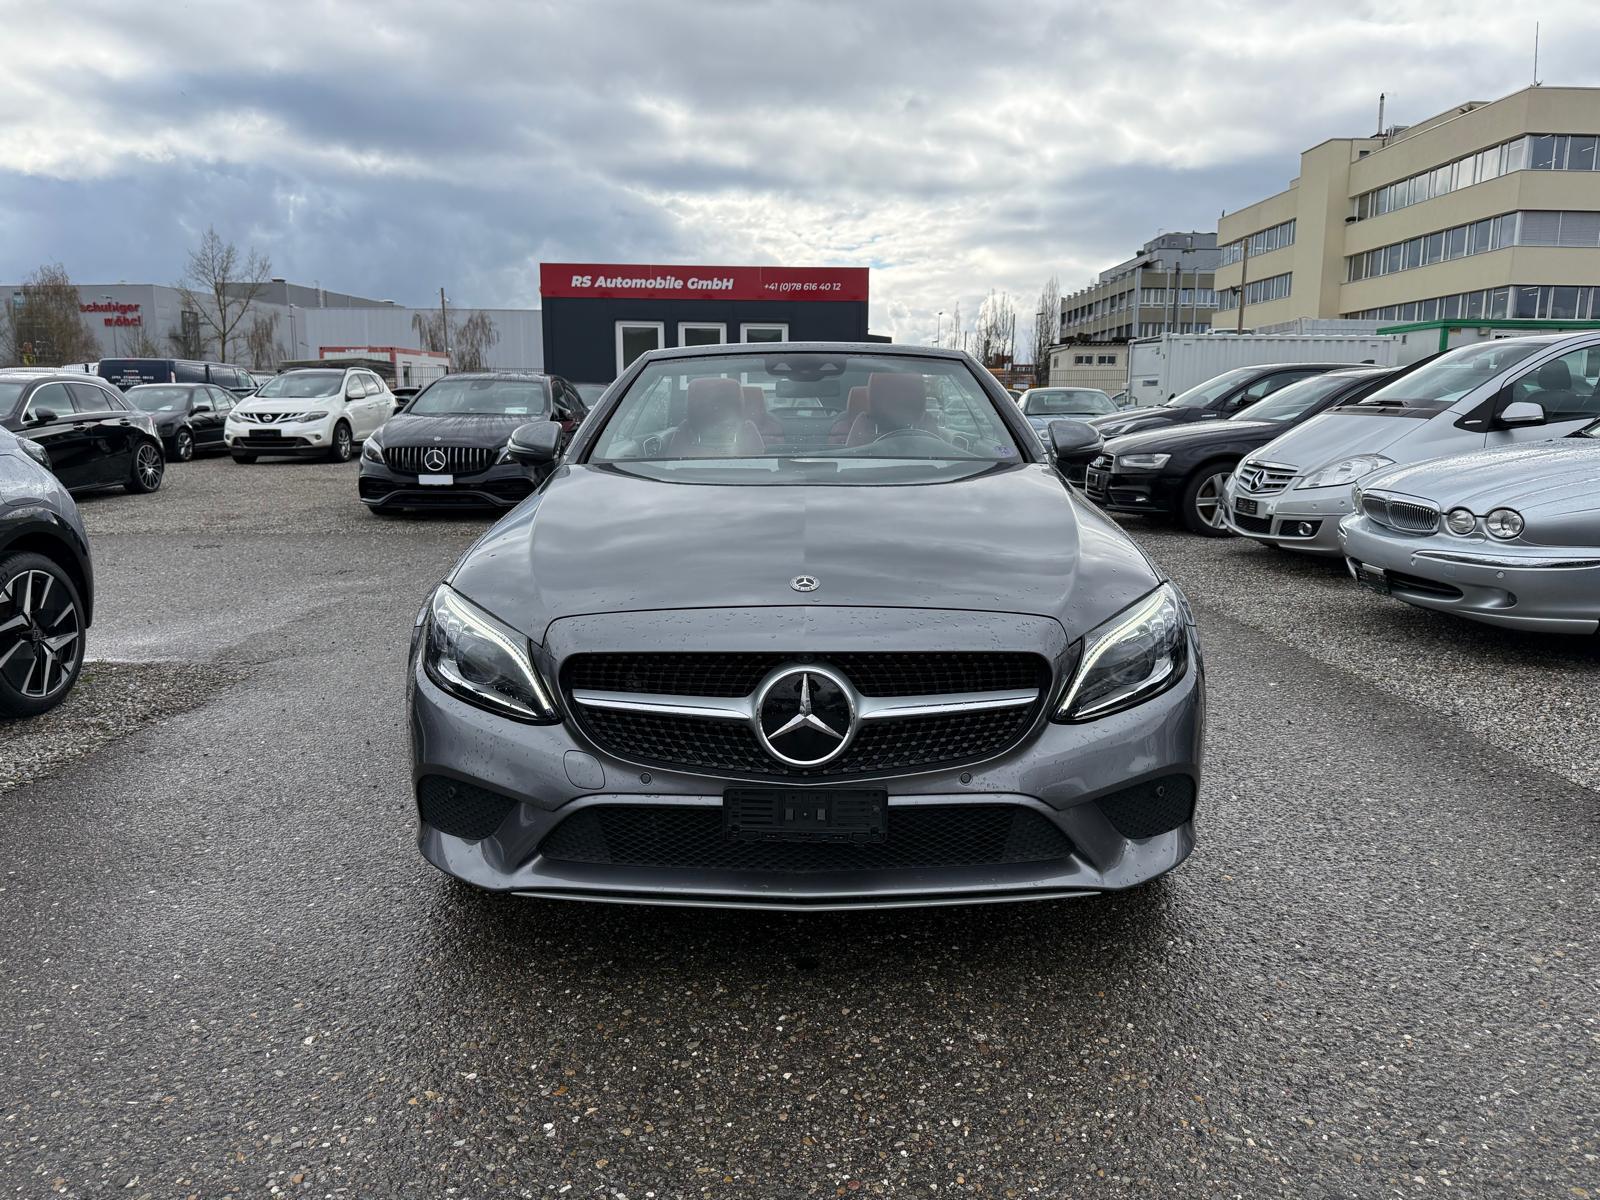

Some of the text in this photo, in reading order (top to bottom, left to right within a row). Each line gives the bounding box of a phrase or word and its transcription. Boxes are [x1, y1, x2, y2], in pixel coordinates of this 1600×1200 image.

[571, 275, 734, 290] RS Automobile GmbH
[764, 282, 842, 292] +41 (0)78 616 40 12
